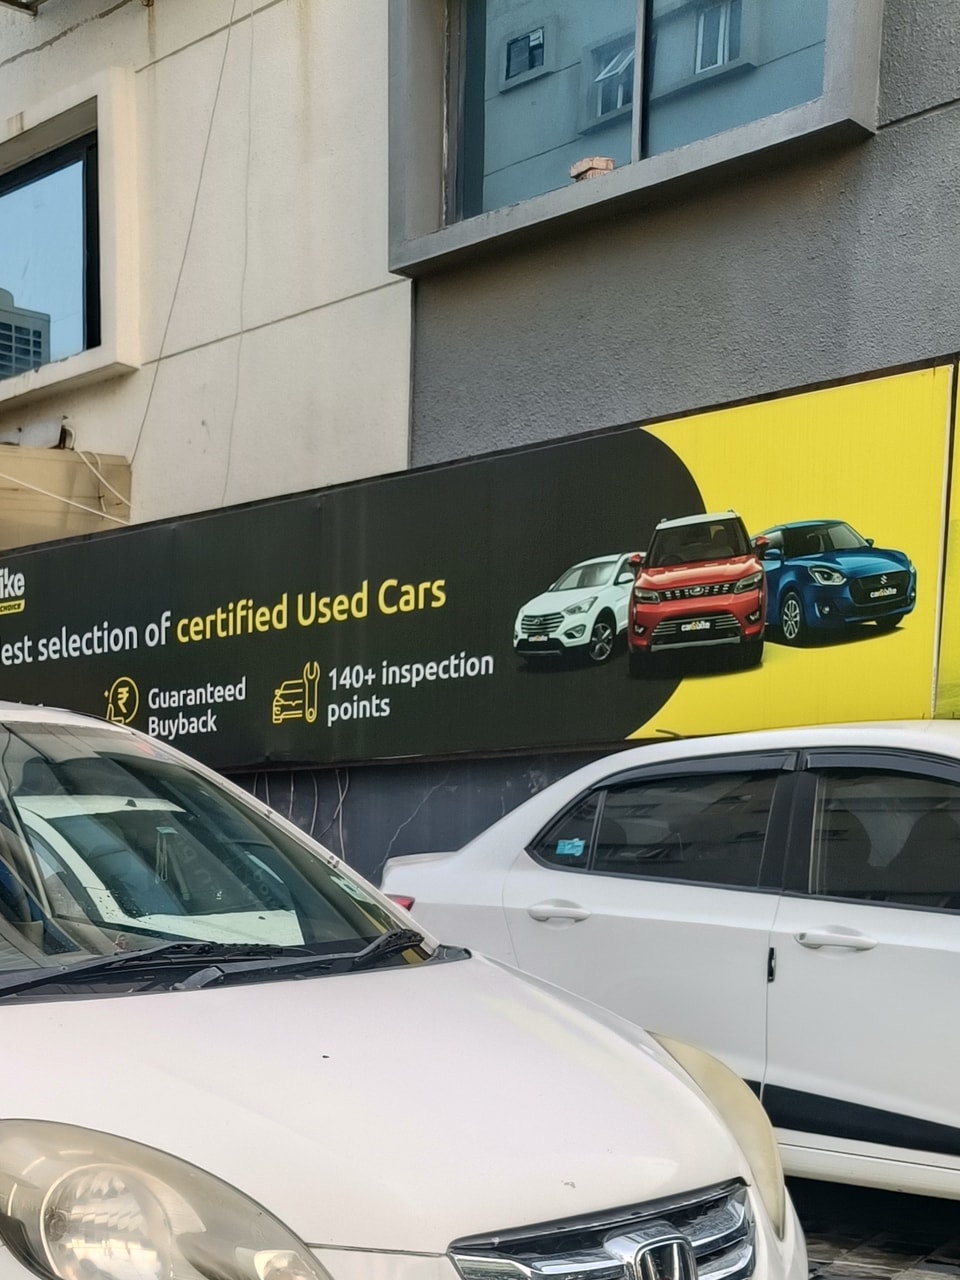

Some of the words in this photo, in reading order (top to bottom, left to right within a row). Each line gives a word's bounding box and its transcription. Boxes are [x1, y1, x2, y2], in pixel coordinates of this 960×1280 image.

[37, 620, 138, 661] selection
[145, 610, 172, 647] of
[176, 592, 288, 643] certified
[296, 579, 368, 627] Used
[378, 578, 446, 615] Cars
[328, 665, 376, 691] 140+
[382, 651, 494, 689] inspection
[148, 676, 246, 709] Guaranteed
[148, 710, 218, 740] Buyback
[327, 695, 391, 727] points
